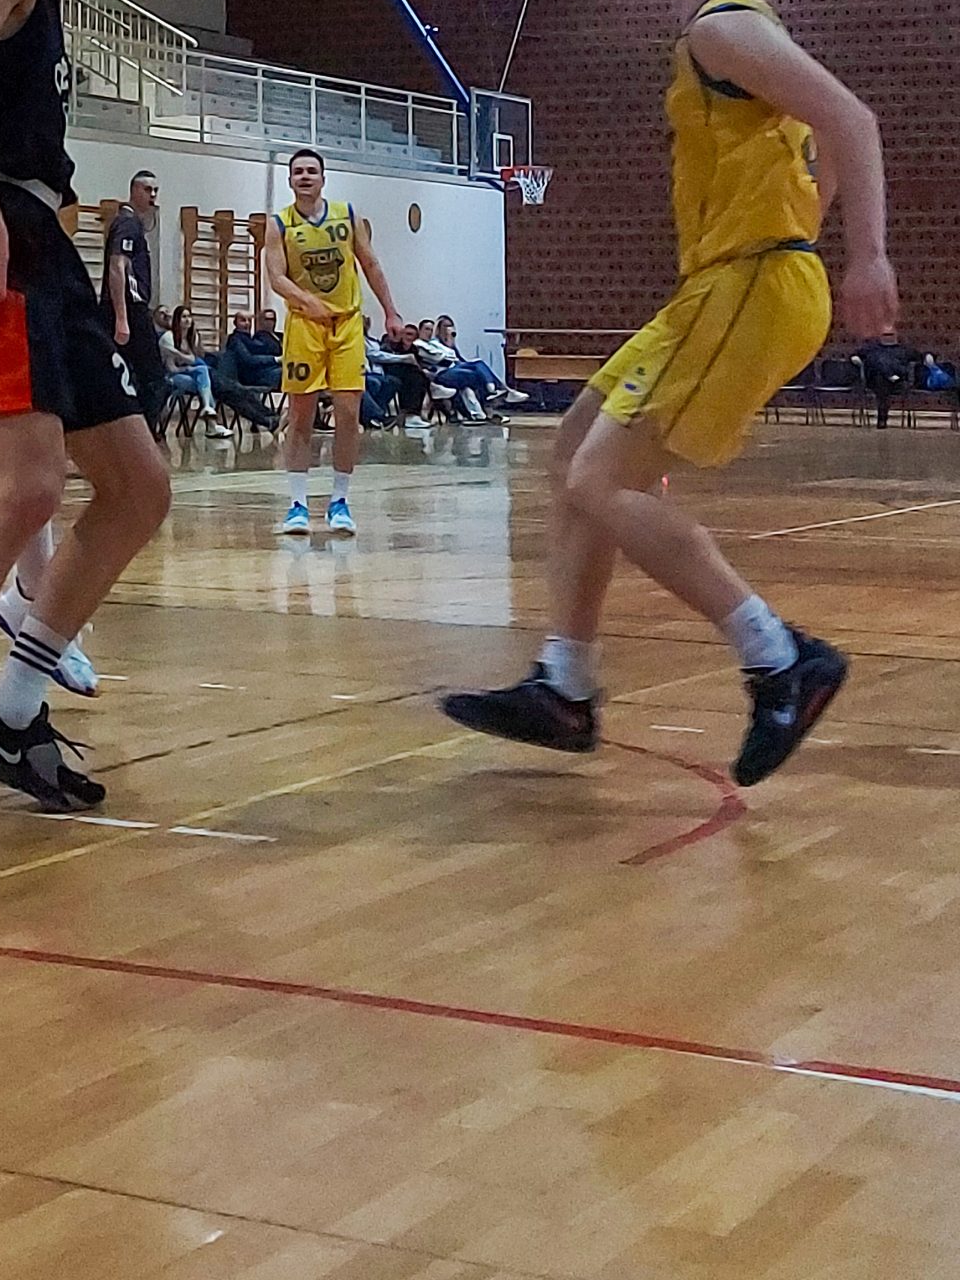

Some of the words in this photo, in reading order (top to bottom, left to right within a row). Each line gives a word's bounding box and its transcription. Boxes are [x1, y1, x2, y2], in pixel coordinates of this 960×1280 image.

[325, 223, 349, 242] 10
[112, 352, 137, 397] 2
[287, 361, 310, 381] 10
